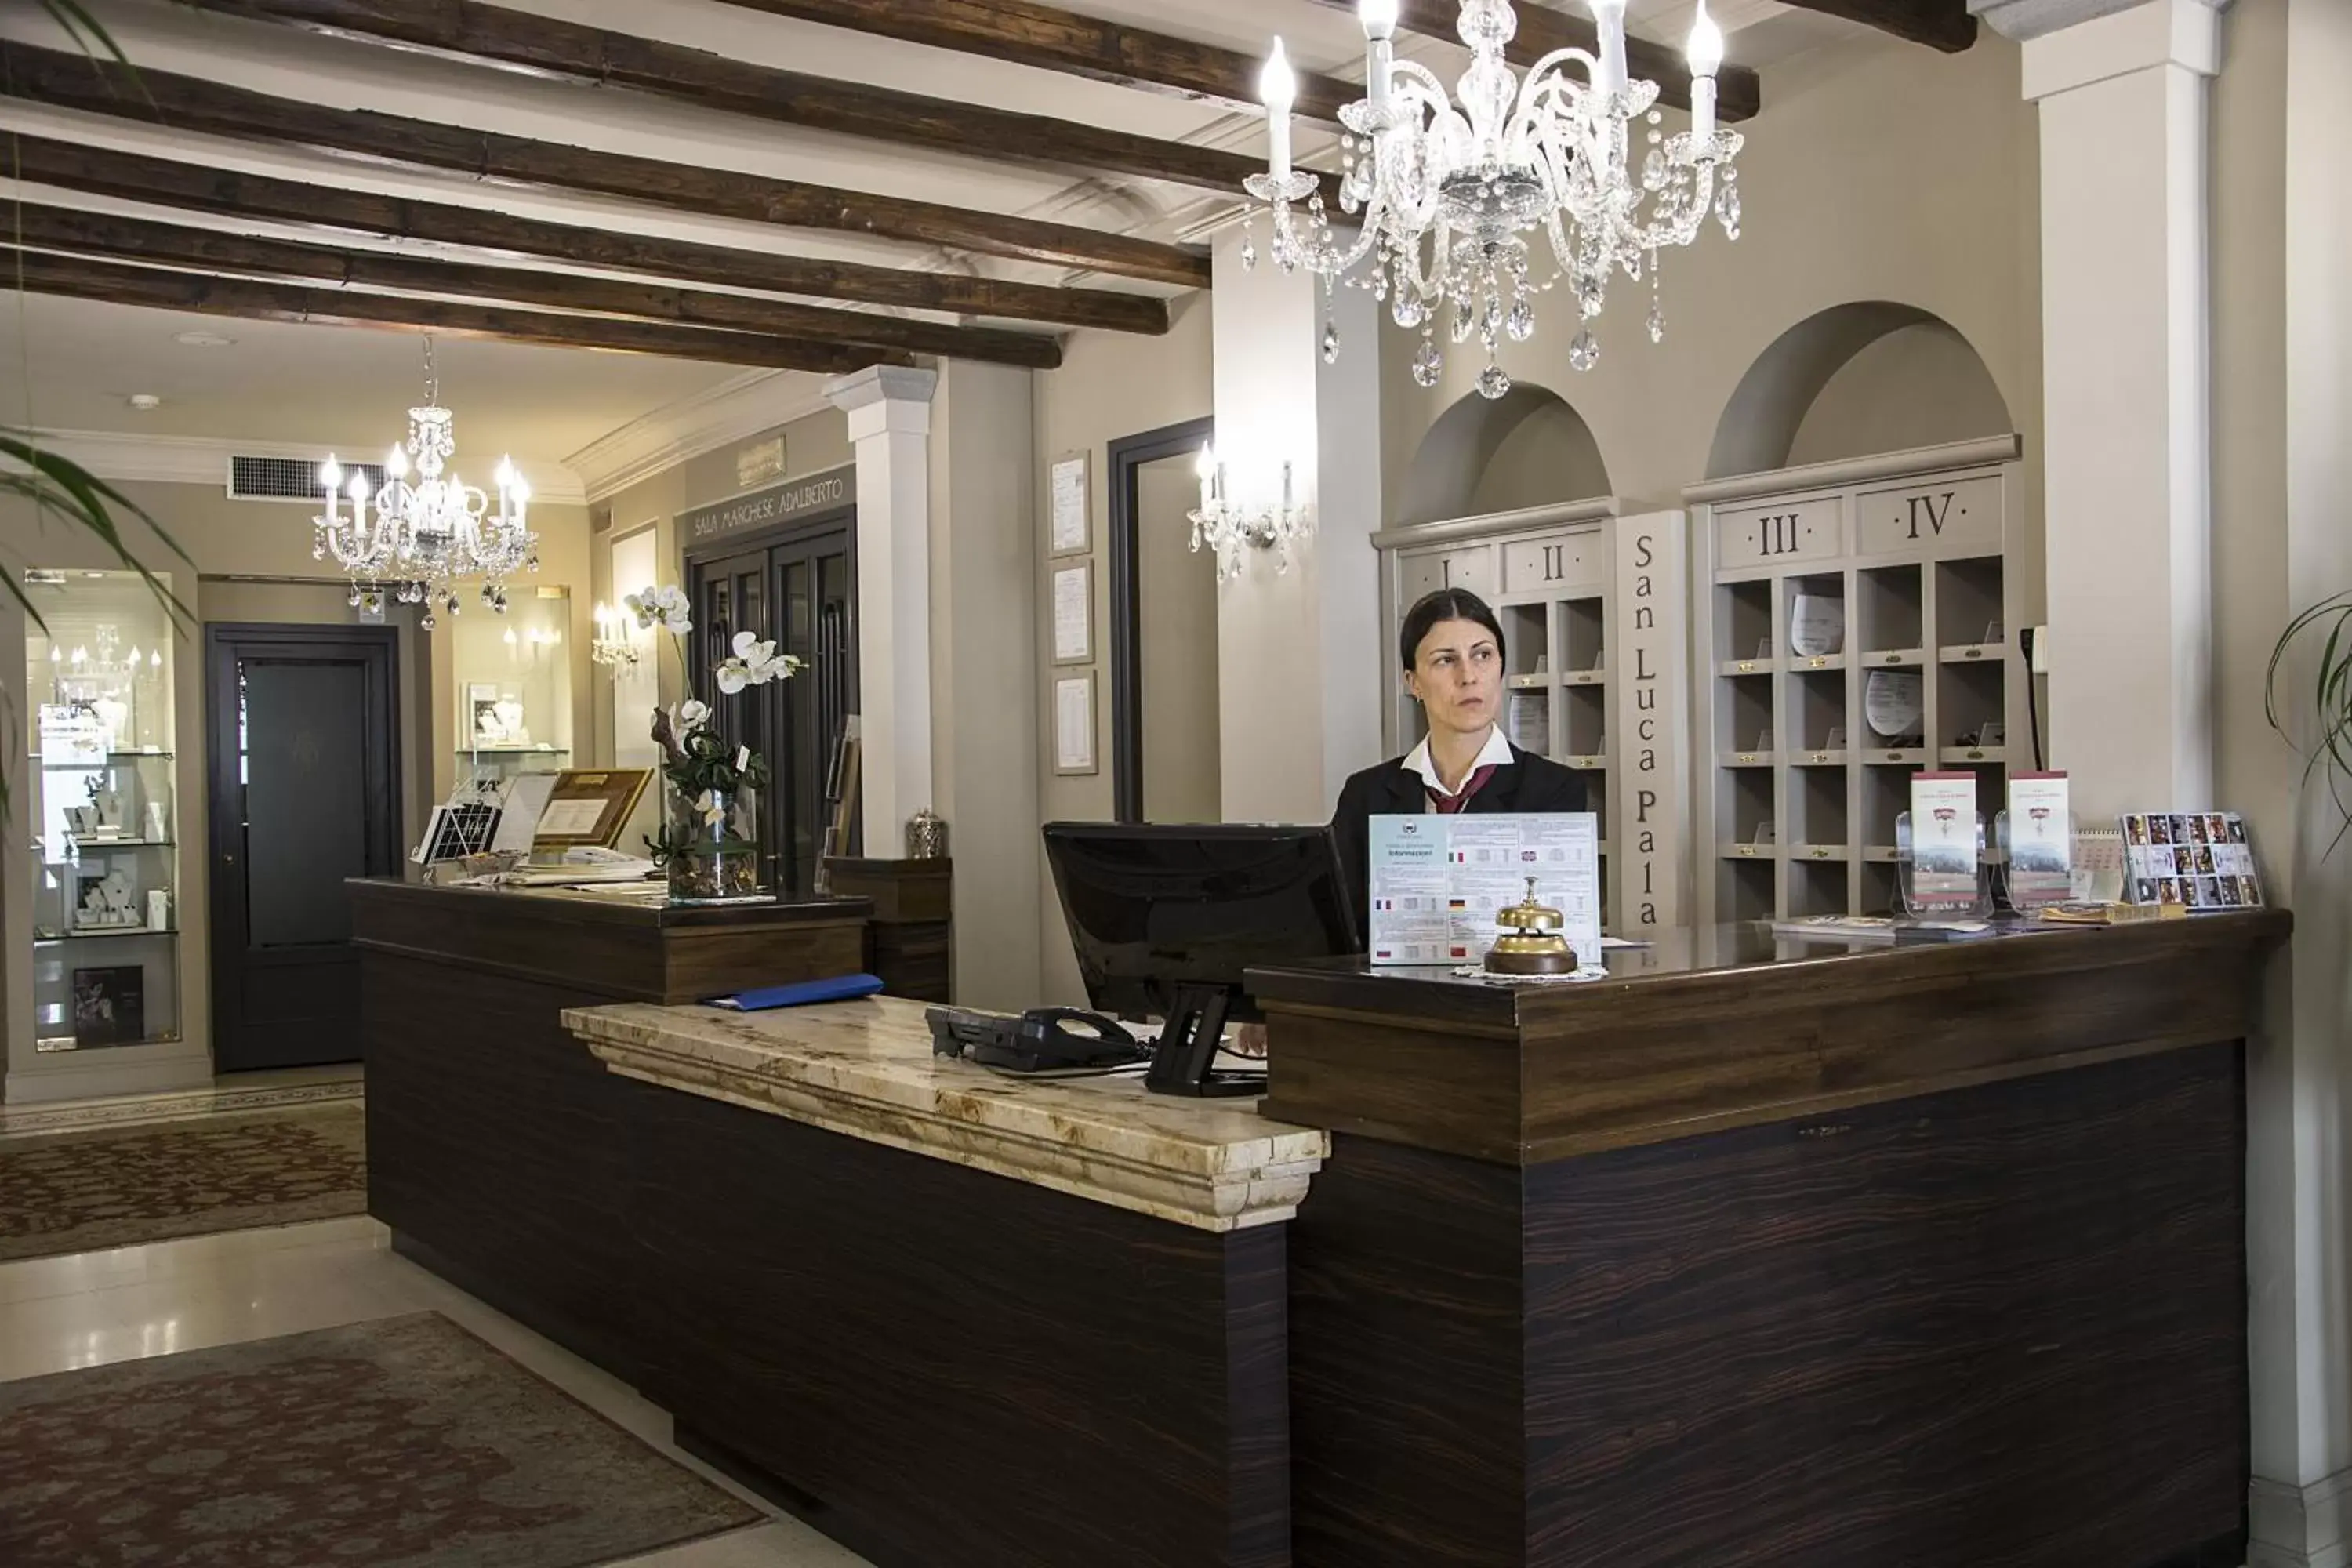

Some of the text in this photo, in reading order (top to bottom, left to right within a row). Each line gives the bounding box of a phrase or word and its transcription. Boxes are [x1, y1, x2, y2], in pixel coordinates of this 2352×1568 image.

[695, 478, 843, 536] SALA MARCHESE ADALBERTO
[1635, 535, 1654, 630] San
[1635, 648, 1657, 771] Luca
